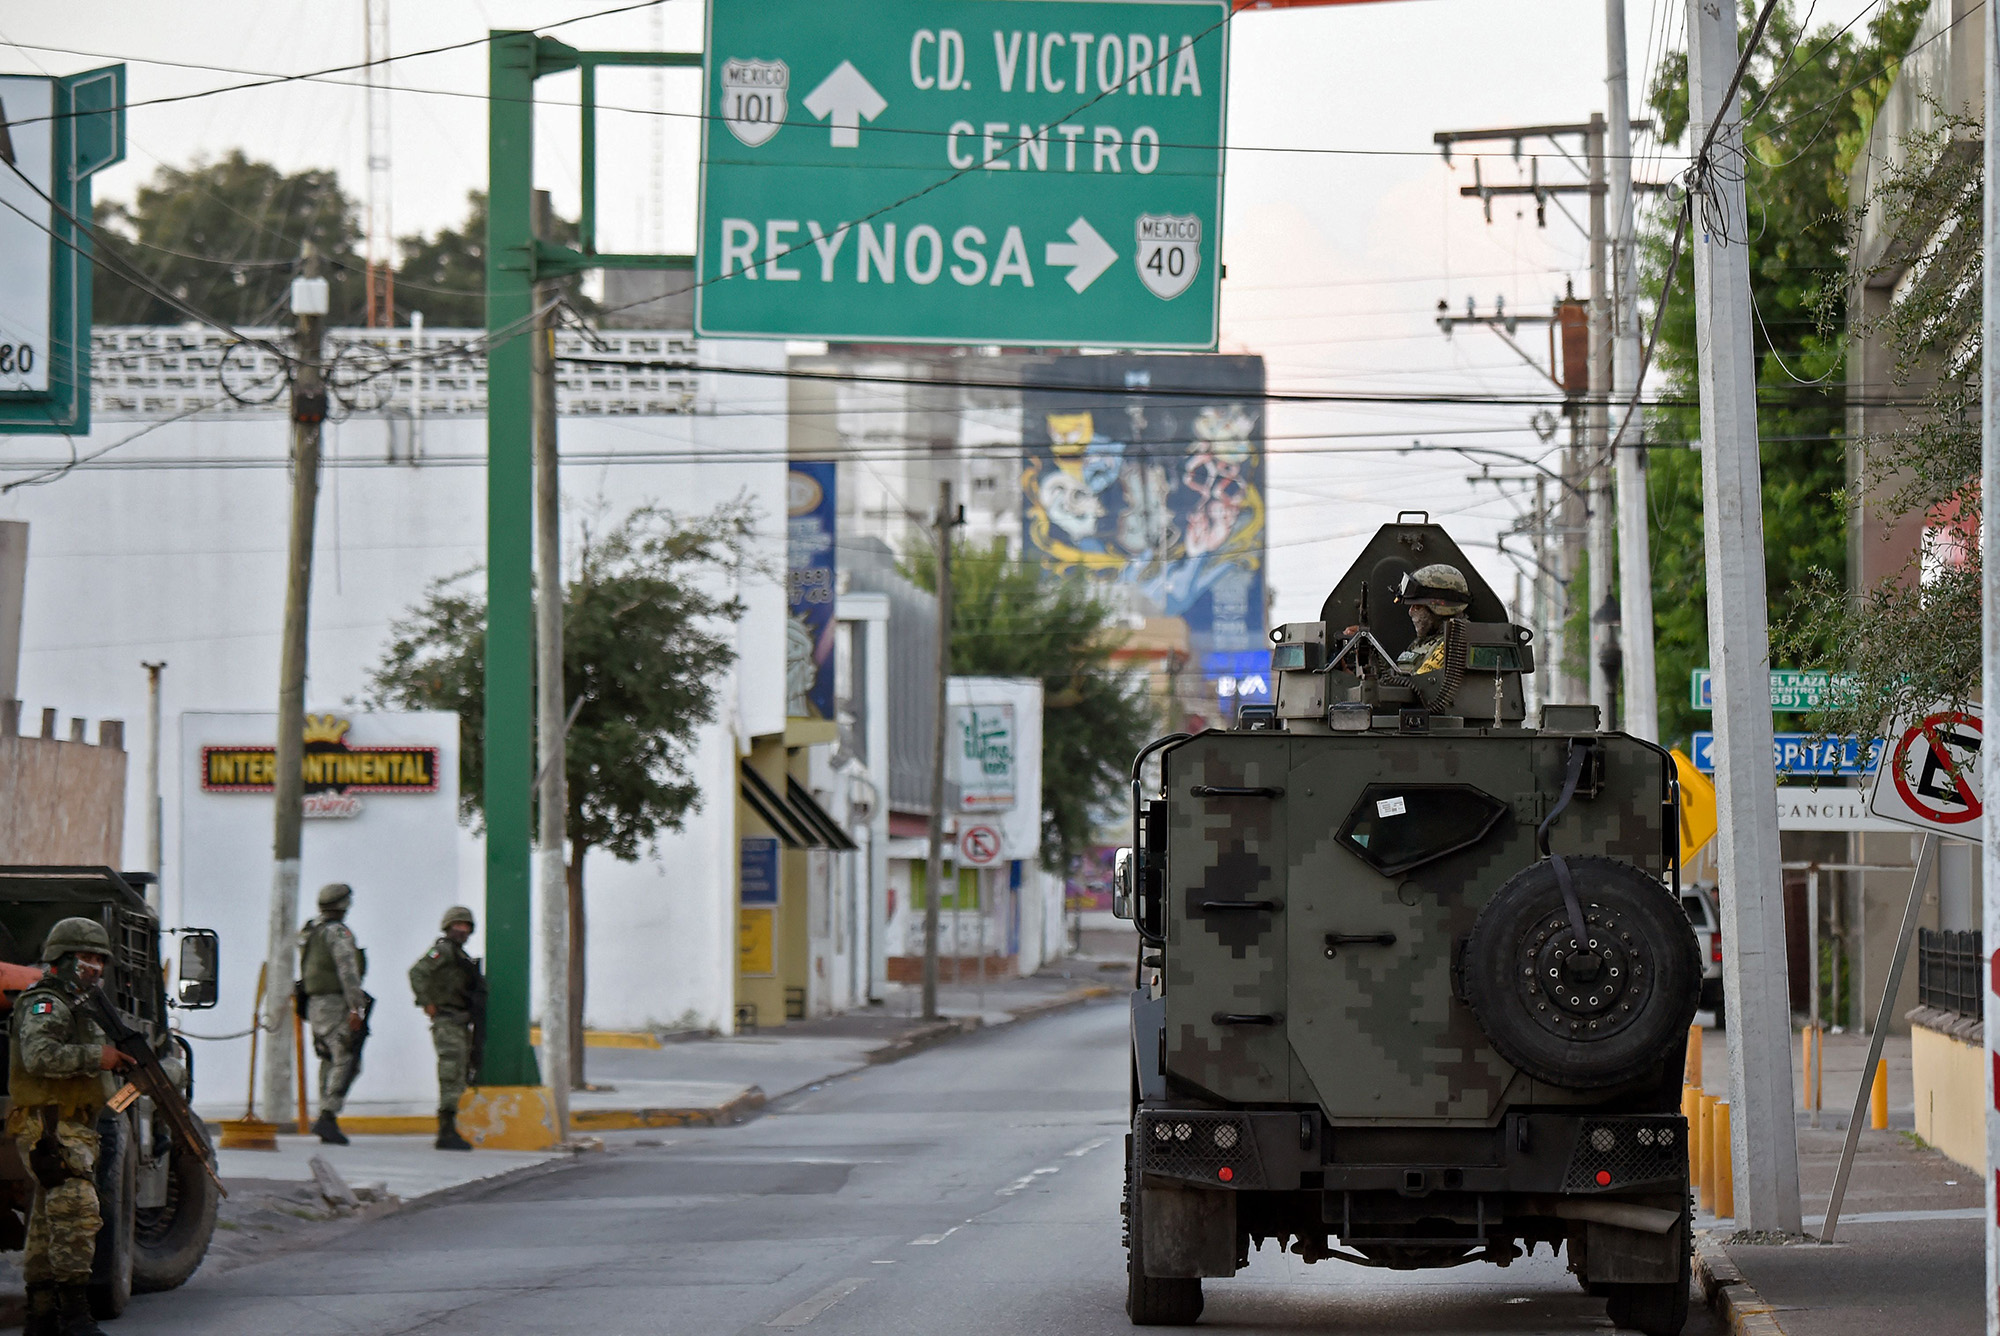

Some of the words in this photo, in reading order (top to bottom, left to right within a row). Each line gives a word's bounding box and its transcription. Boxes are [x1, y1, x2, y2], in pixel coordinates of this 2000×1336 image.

[729, 67, 785, 85] MEXICO
[911, 29, 972, 91] CD.
[994, 30, 1202, 97] VICTORIA
[736, 93, 772, 125] 101
[947, 121, 1160, 175] CENTRO
[1142, 222, 1198, 239] MEXICO
[720, 218, 1035, 288] REYNOSA
[1146, 246, 1185, 278] 40
[1770, 686, 1815, 695] CENTRO
[1788, 676, 1827, 687] PLAZA
[1770, 694, 1801, 708] 68)
[210, 753, 431, 784] INTERNTINENTAL
[1774, 742, 1854, 767] SPITAL
